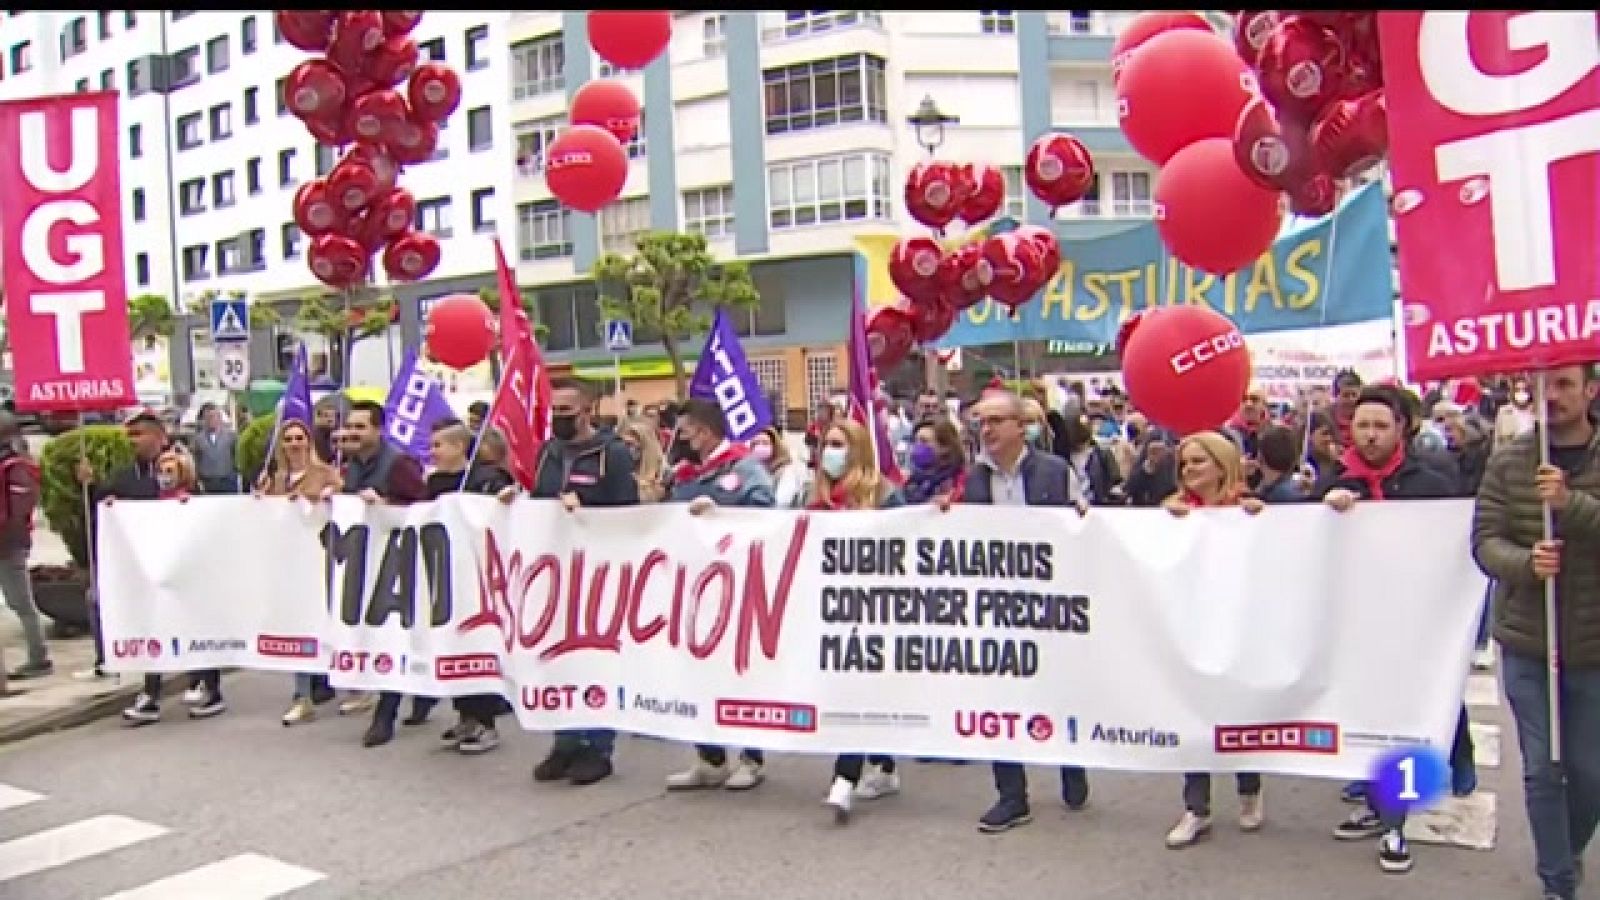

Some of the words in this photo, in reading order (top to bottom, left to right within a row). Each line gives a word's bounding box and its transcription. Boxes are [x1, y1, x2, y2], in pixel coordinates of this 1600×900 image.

[19, 106, 105, 373] UGT
[1042, 243, 1321, 325] ASTURIAS
[224, 360, 243, 375] 30
[1170, 330, 1244, 374] CCOO
[29, 378, 124, 398] ASTURIAS
[821, 538, 905, 576] SUBIR
[916, 538, 1053, 580] SALARIOS
[820, 586, 968, 626] CONTENER
[975, 589, 1090, 633] PRECIOS
[440, 659, 497, 676] CCOO
[820, 626, 884, 672] MÁS
[894, 635, 1039, 677] IGUALDAD
[521, 685, 577, 711] UGT
[633, 693, 699, 718] Asturias
[720, 703, 786, 722] CCOO
[954, 710, 1021, 740] UGT
[1090, 722, 1180, 749] Asturias
[1219, 728, 1301, 748] CCOO
